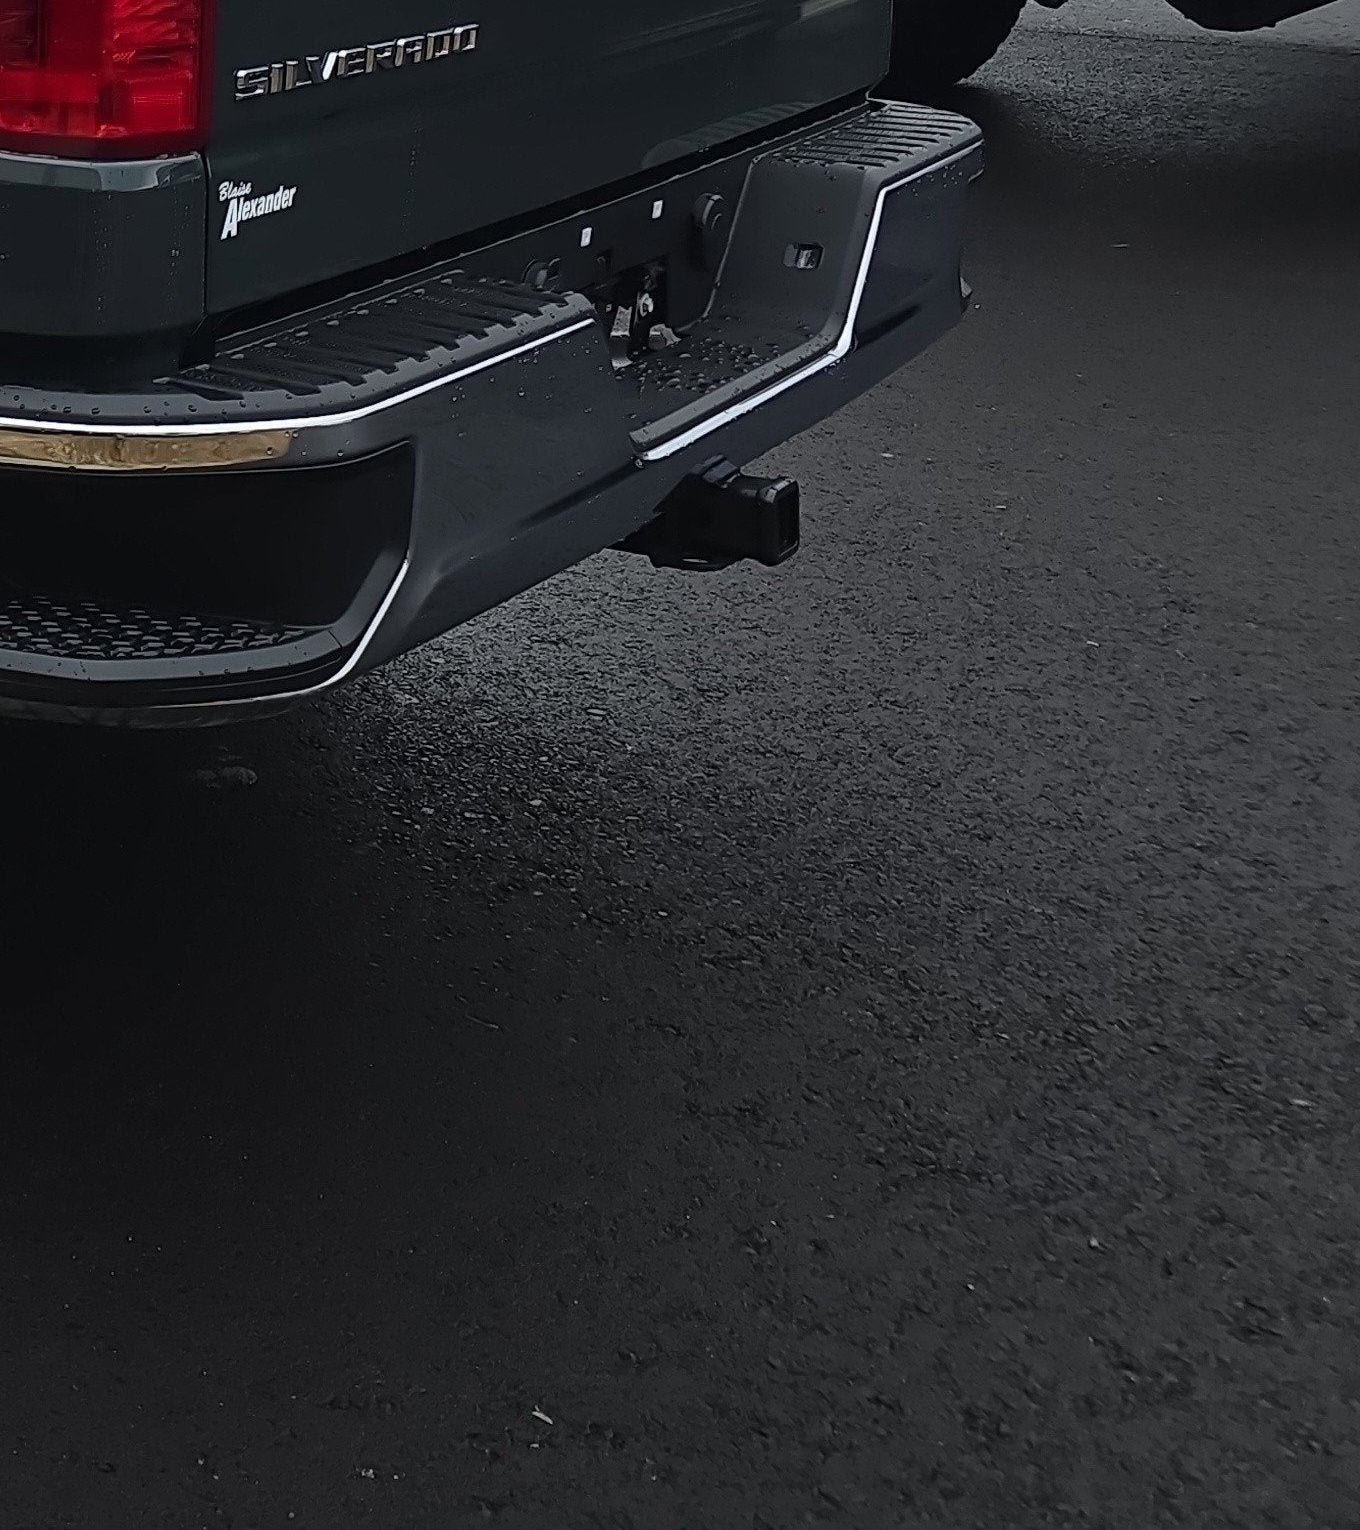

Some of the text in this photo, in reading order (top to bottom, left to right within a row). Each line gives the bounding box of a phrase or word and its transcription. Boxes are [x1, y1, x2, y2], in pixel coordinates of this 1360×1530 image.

[233, 23, 480, 101] SILVERADO
[219, 181, 252, 201] Blaise
[220, 185, 297, 240] Alexander
